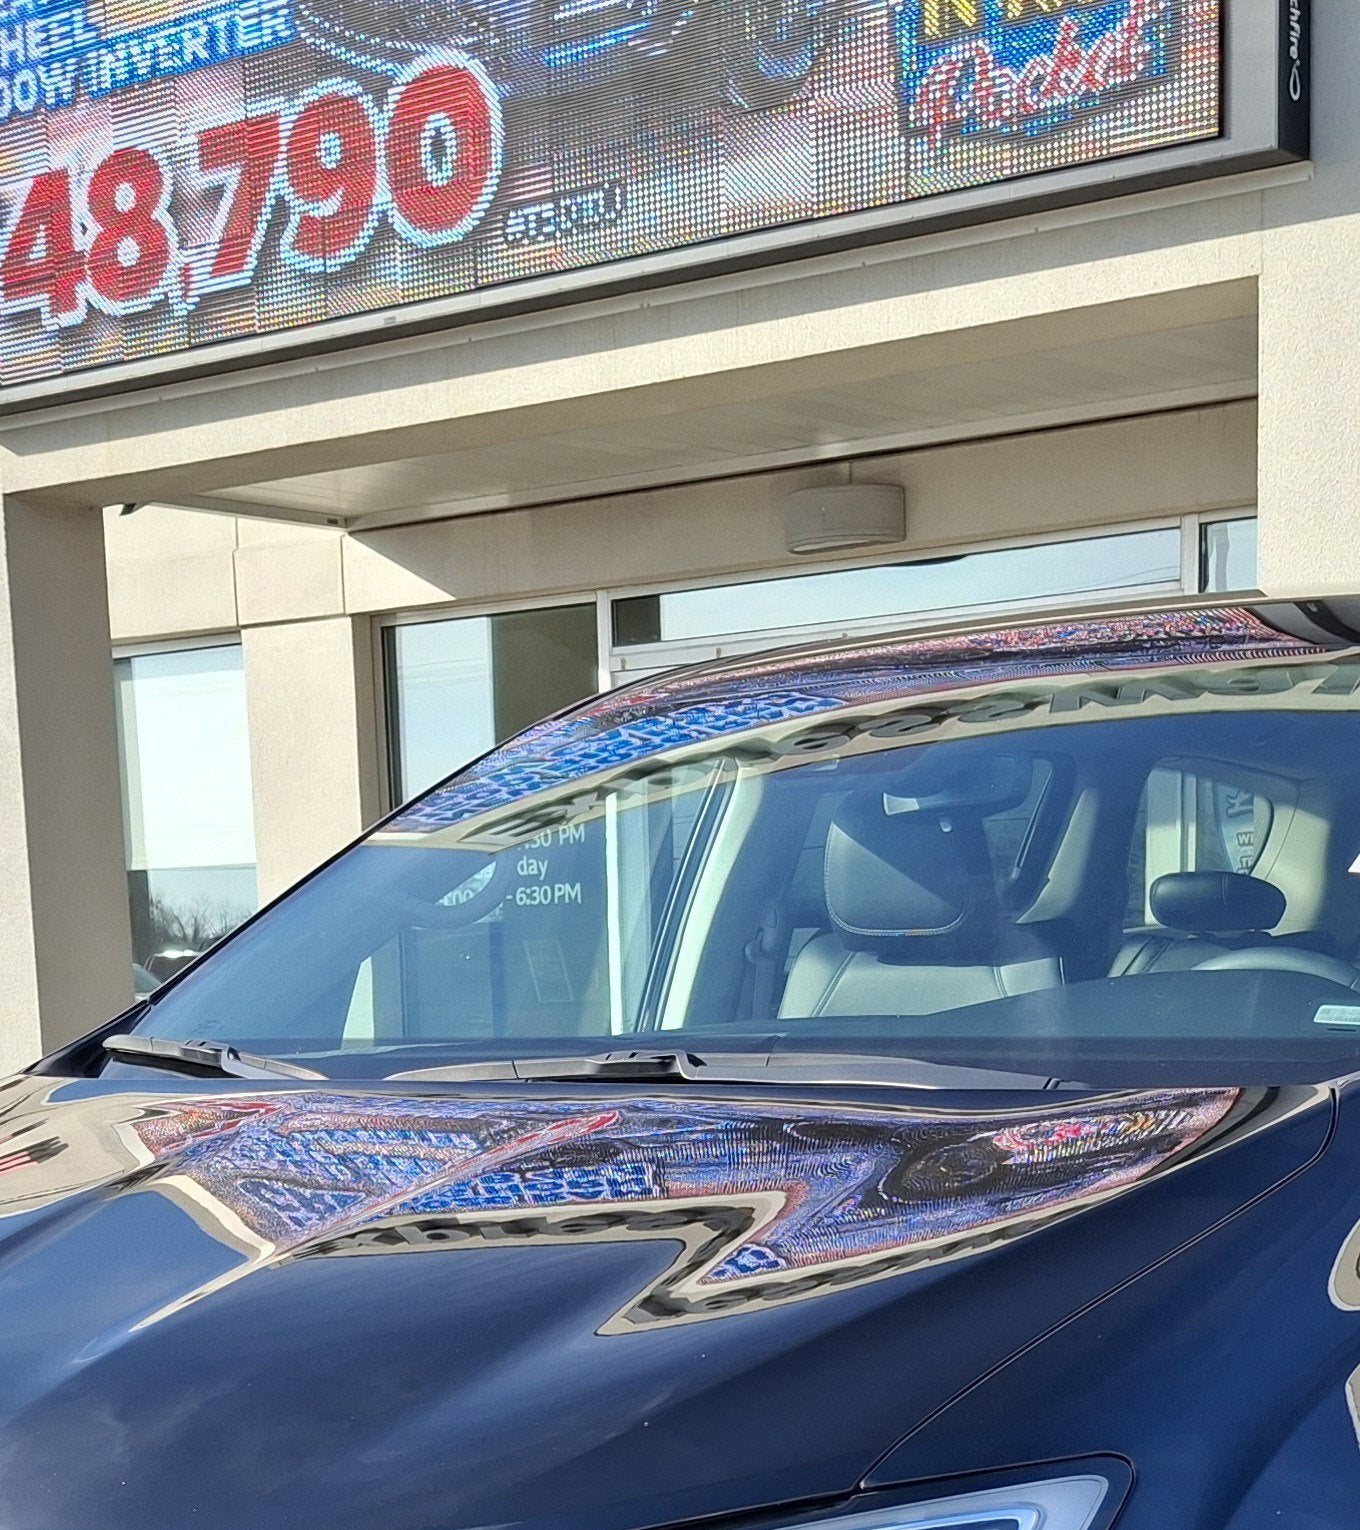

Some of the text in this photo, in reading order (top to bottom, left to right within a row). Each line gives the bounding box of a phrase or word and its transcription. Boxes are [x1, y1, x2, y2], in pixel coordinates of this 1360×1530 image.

[86, 8, 293, 94] INVERTER
[559, 823, 585, 845] PM
[517, 855, 548, 880] day
[516, 885, 551, 906] 6:30
[554, 883, 582, 905] PM
